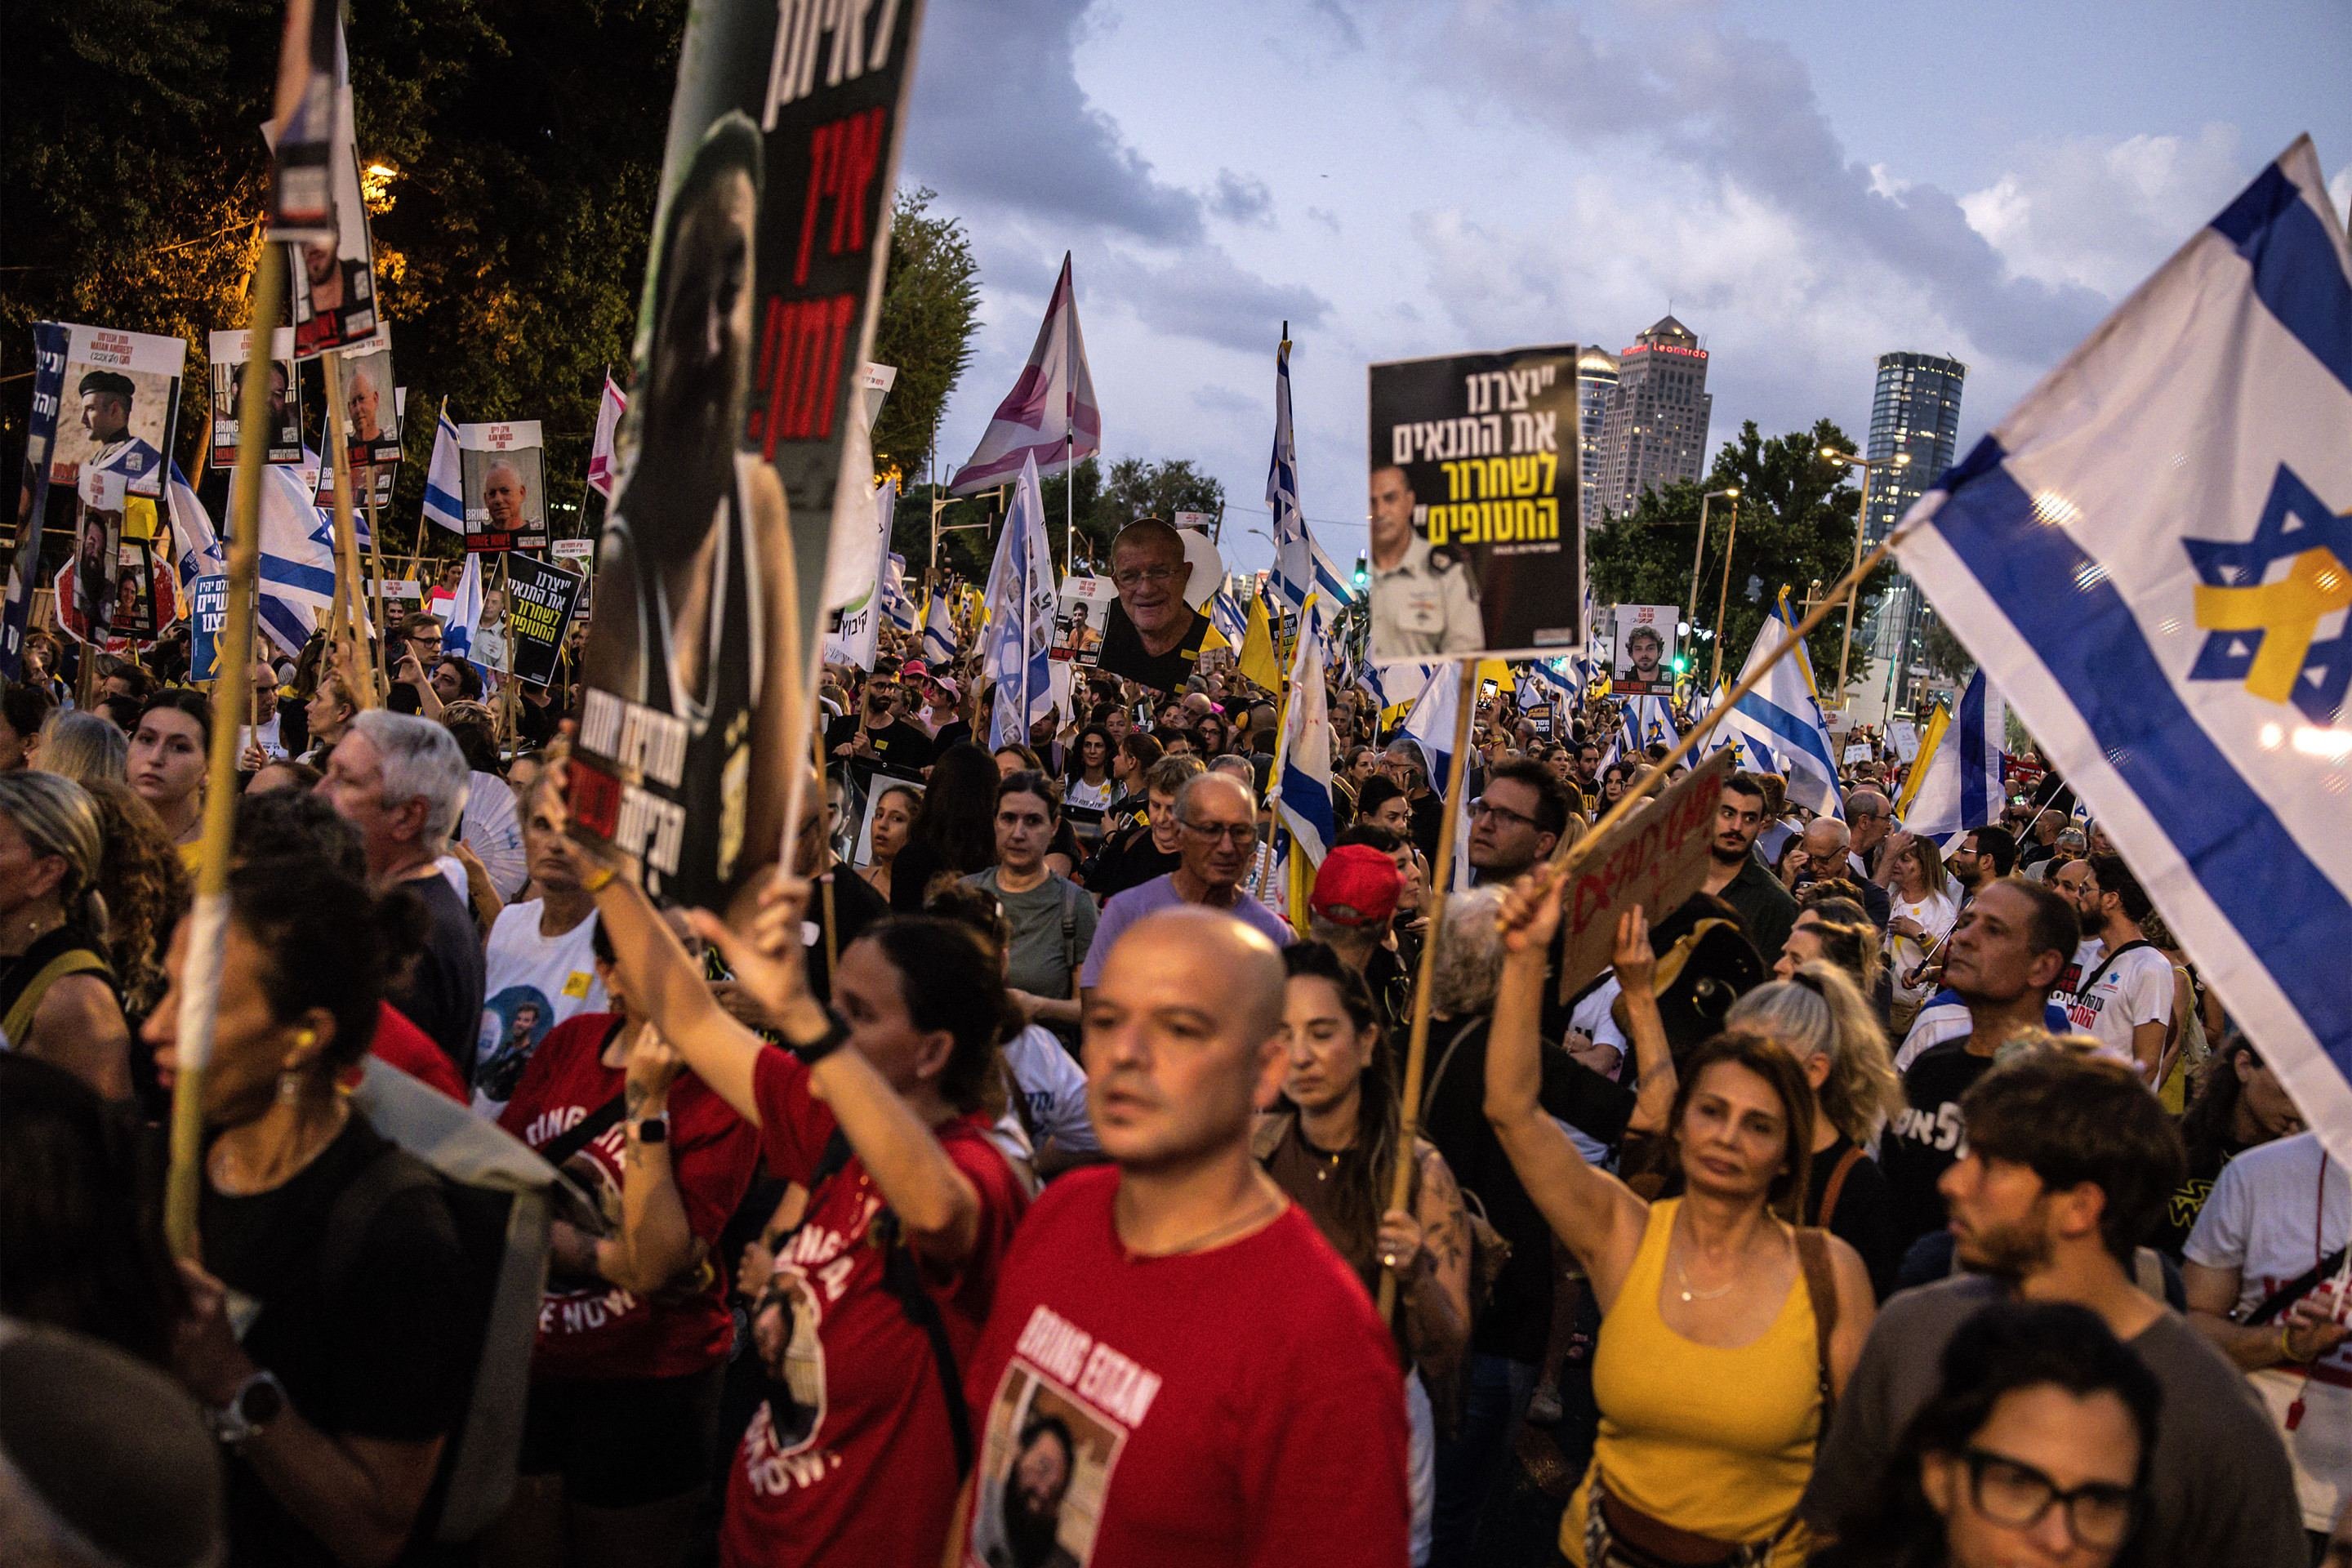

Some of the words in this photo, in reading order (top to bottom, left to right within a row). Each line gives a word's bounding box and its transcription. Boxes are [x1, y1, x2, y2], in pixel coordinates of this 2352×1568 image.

[1653, 341, 1708, 359] Leonardo
[216, 420, 239, 433] BRING
[1511, 410, 1559, 453] את
[216, 433, 230, 446] HIM
[1392, 414, 1503, 465] התנאים
[1440, 452, 1558, 501] לשחרור
[466, 508, 490, 521] BRING
[466, 521, 482, 533] HIM
[501, 577, 547, 605] התנאי
[518, 598, 562, 626] לשחרור
[546, 595, 566, 612] את
[841, 609, 868, 642] קיבוץ
[2051, 990, 2078, 1006] OM
